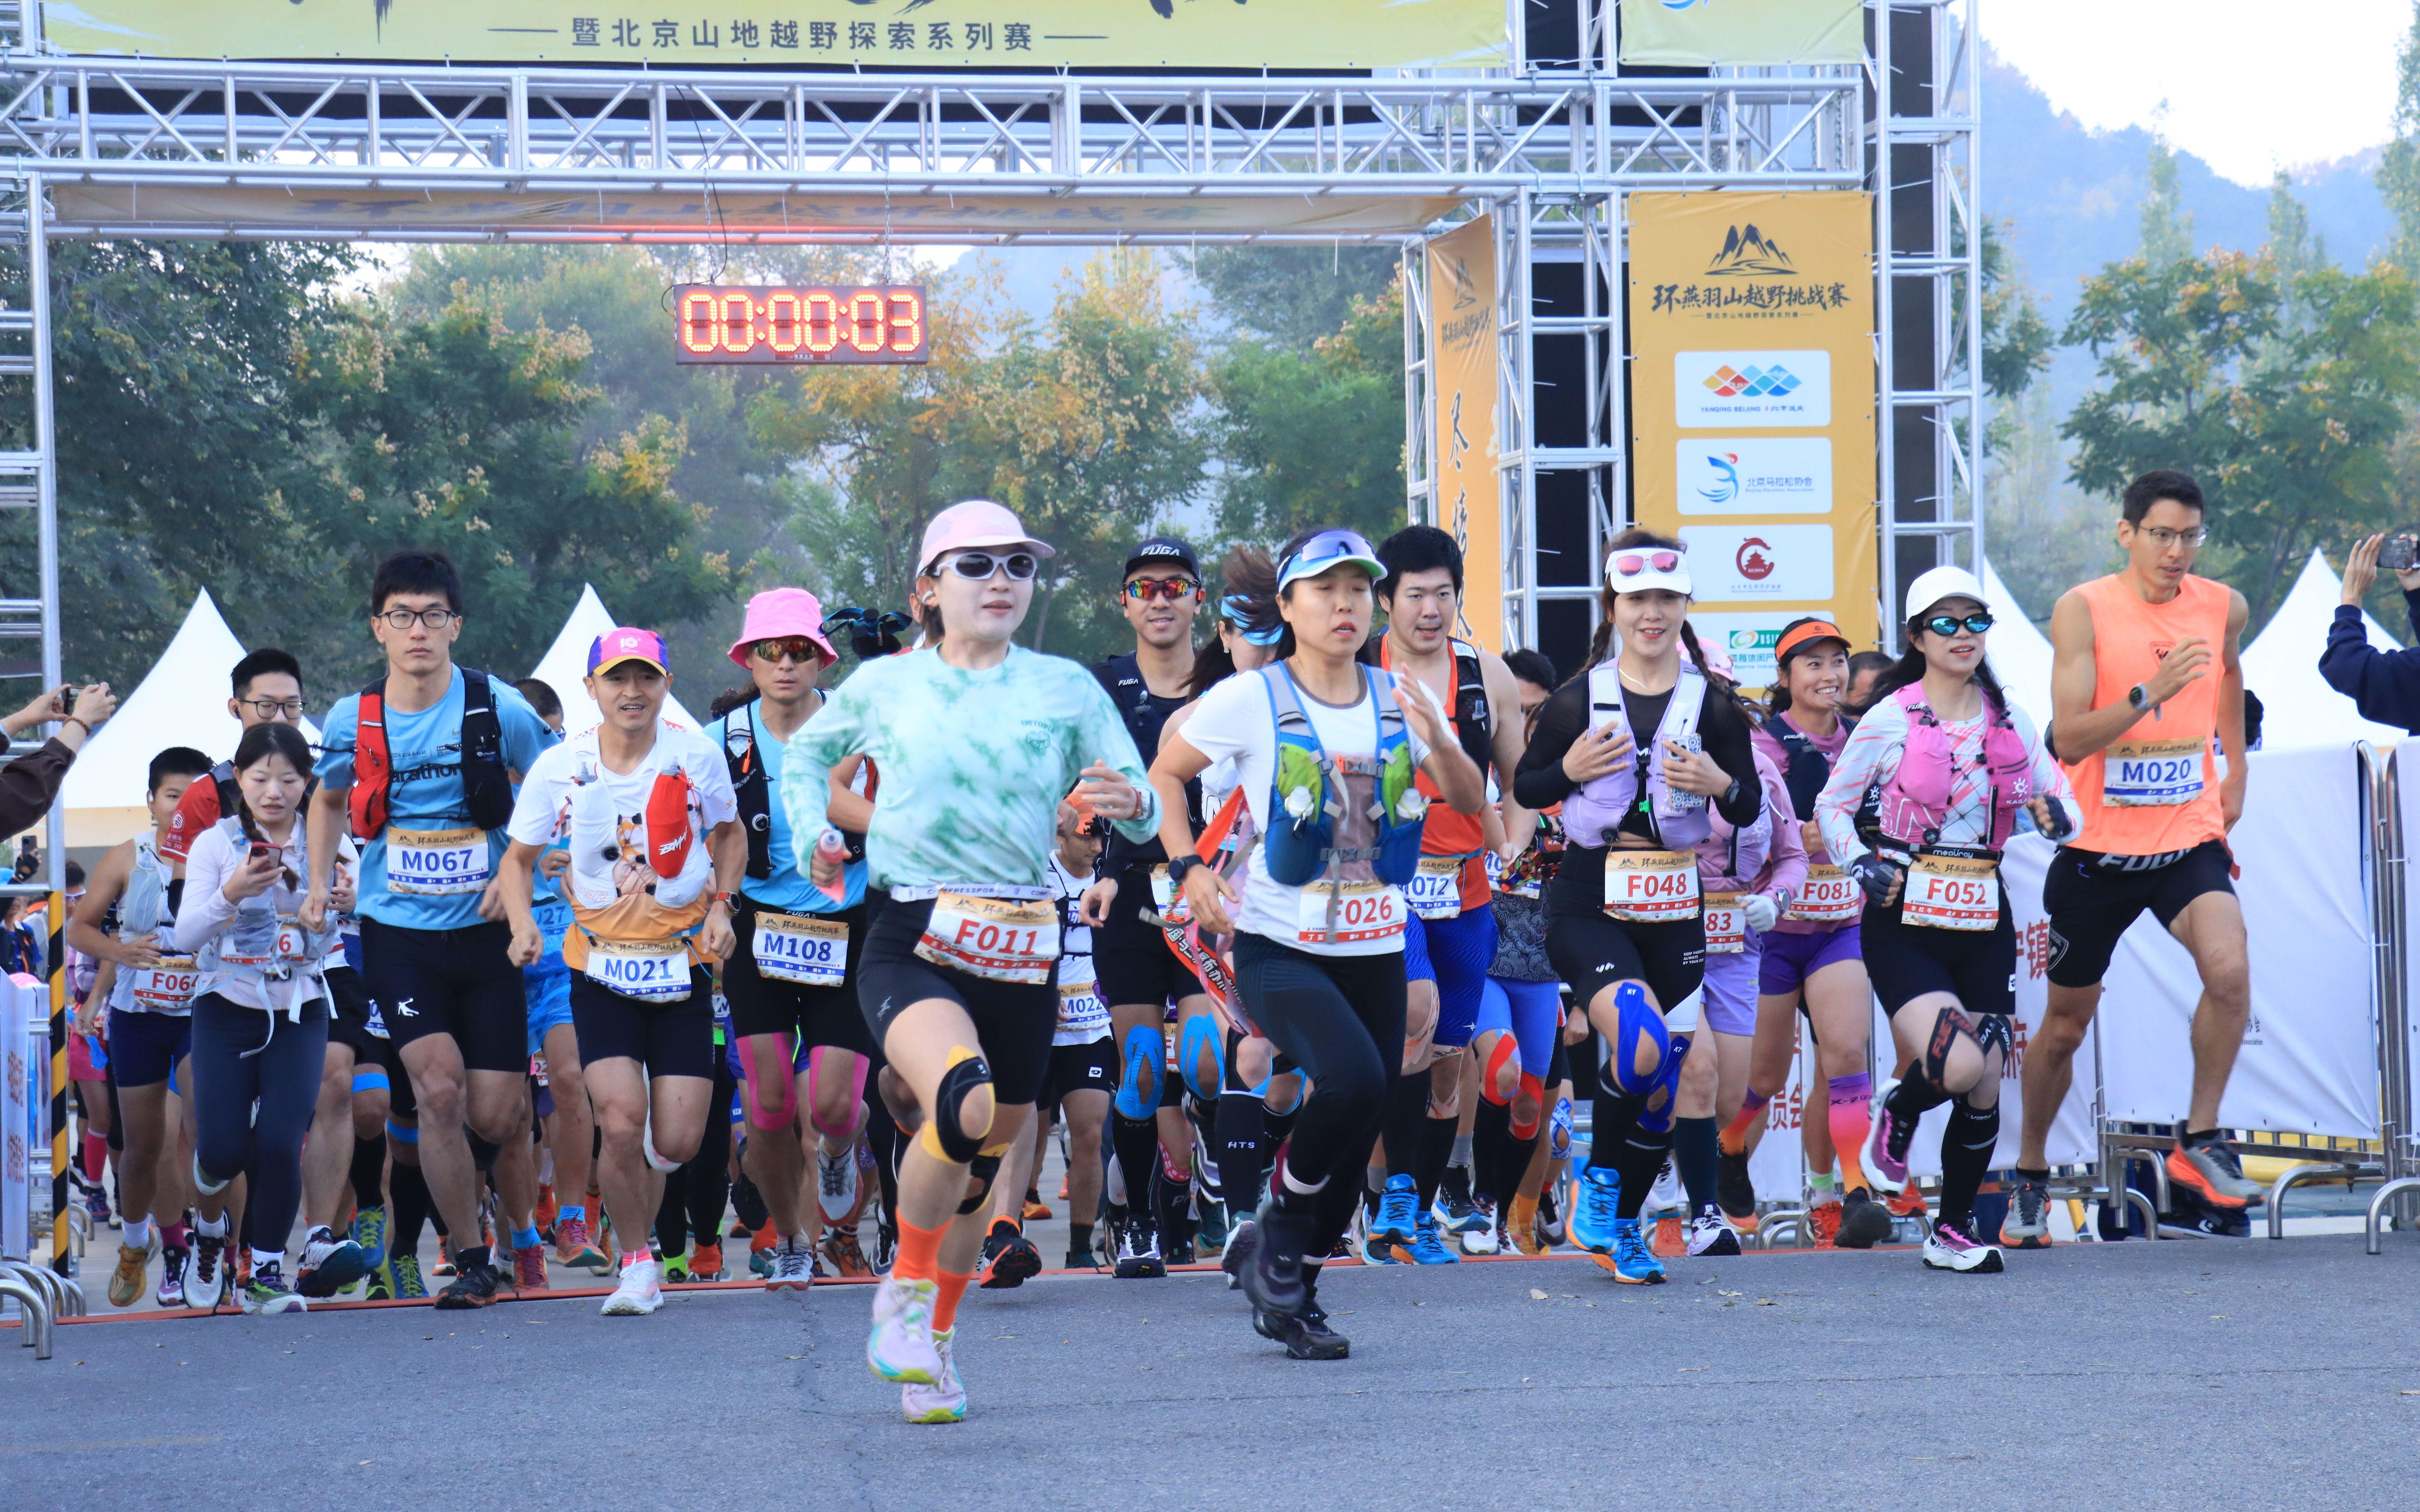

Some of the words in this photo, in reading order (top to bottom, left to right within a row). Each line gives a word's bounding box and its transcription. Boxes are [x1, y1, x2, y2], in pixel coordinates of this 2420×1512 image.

[572, 18, 1032, 51] 暨北京山地越野探索系列赛
[1652, 282, 1851, 320] 环燕羽山越野挑战赛
[684, 293, 920, 352] 00:00:03
[1746, 476, 1813, 487] 北京马拉松协会
[1141, 545, 1180, 556] FUGA
[1118, 678, 1138, 686] FUGA
[2122, 759, 2191, 783] M020
[402, 849, 473, 872] M067
[1627, 873, 1686, 898] F048
[1803, 880, 1852, 901] F081
[1927, 878, 1986, 905] F052
[764, 933, 831, 962] M108
[953, 918, 1038, 956] F011
[606, 958, 674, 982] M021
